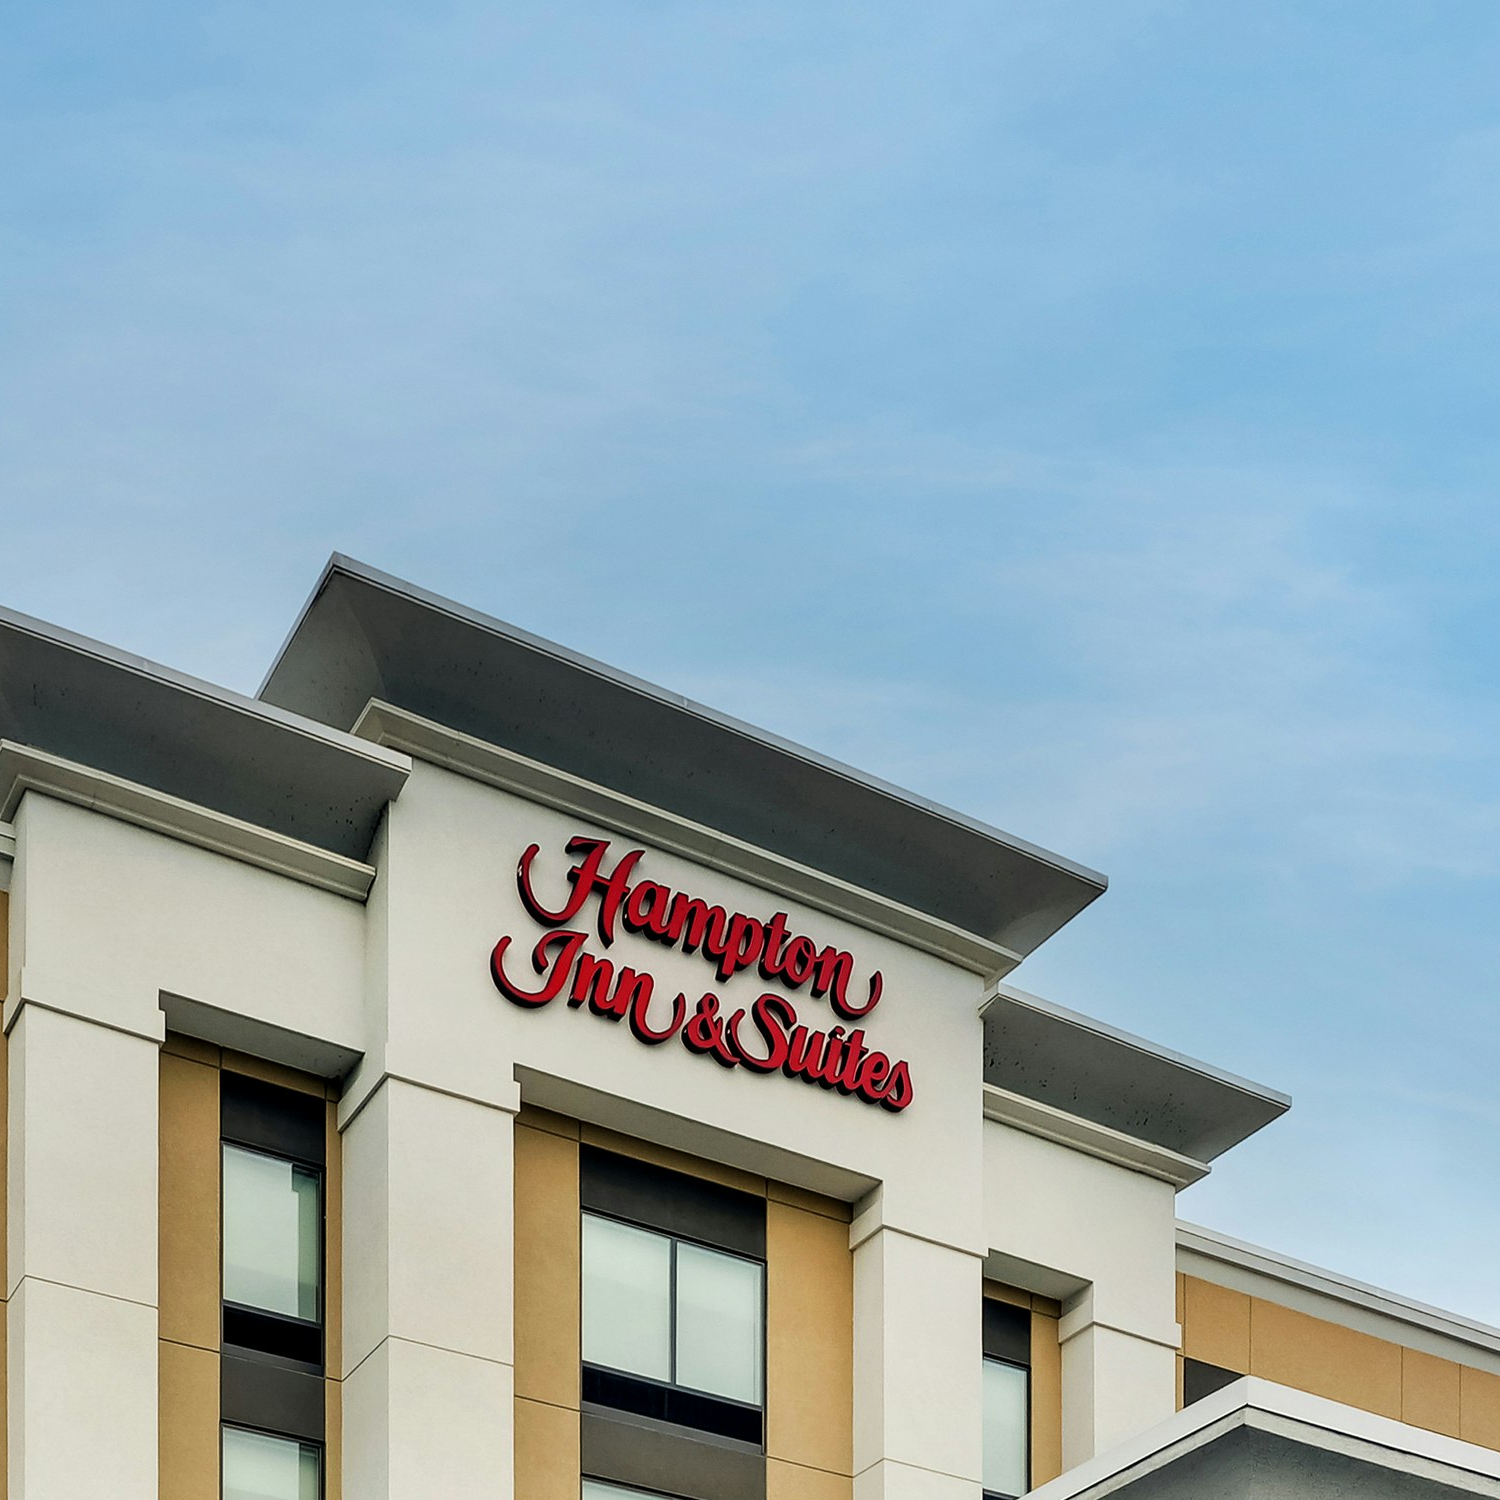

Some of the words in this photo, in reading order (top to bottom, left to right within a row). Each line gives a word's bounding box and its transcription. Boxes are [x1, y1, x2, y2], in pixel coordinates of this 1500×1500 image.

[516, 836, 883, 1021] Hampton
[490, 930, 687, 1046] Inn
[725, 993, 915, 1114] Suites
